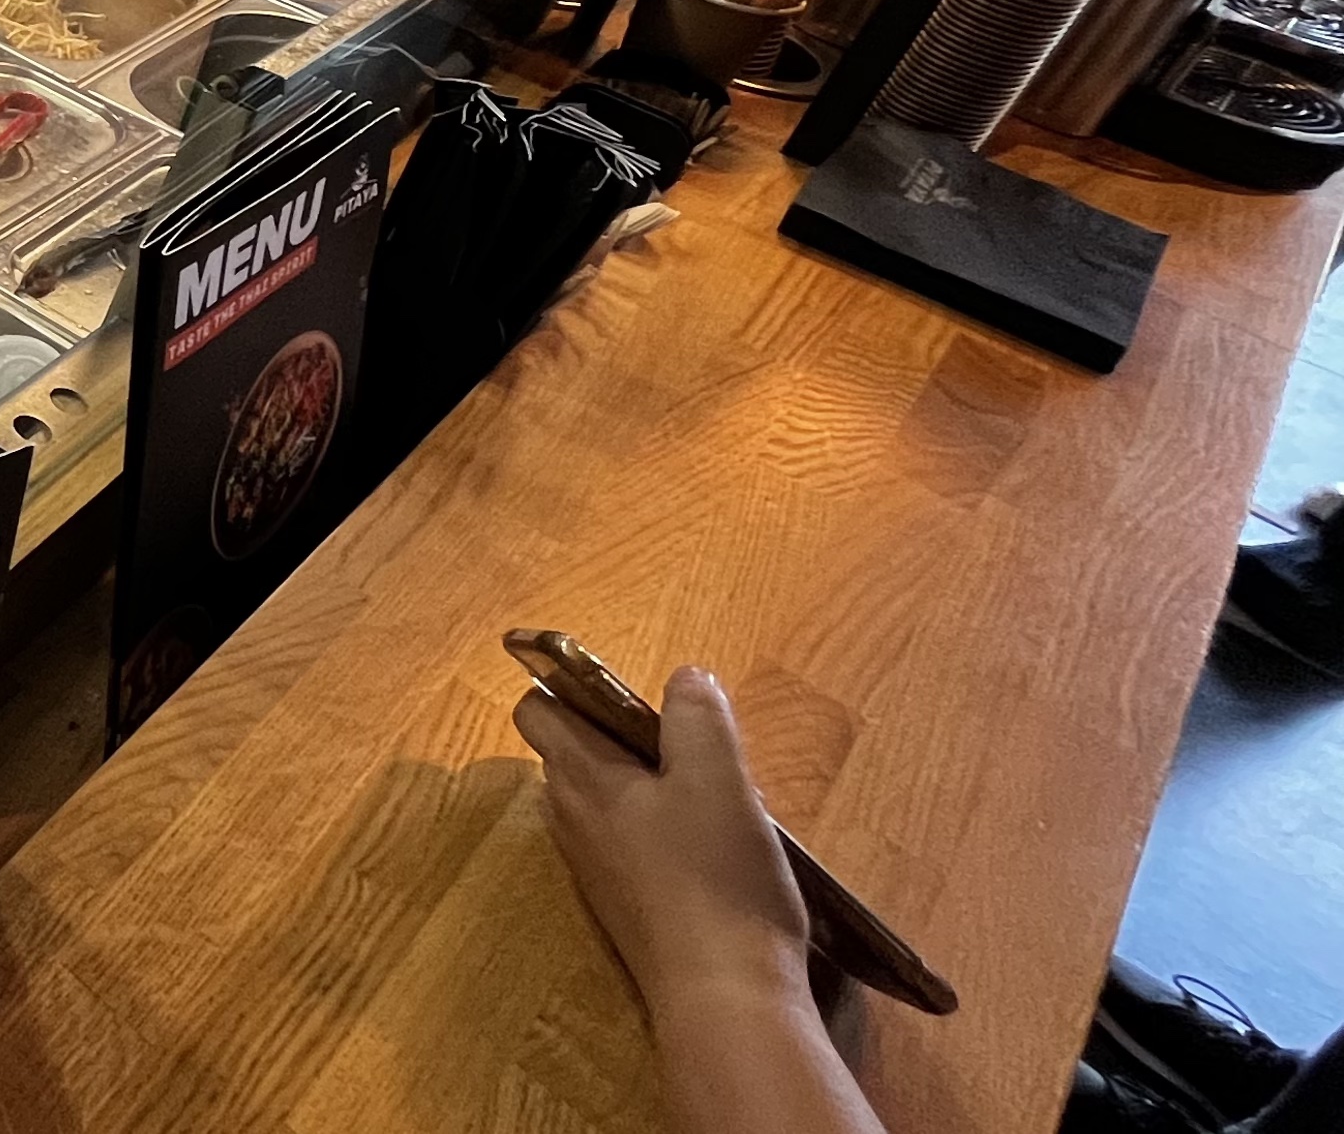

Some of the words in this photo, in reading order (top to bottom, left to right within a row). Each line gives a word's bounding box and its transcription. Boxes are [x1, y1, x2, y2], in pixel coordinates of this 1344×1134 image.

[334, 182, 378, 224] PITAYA
[174, 176, 327, 330] MENU
[169, 320, 210, 361] TASTE
